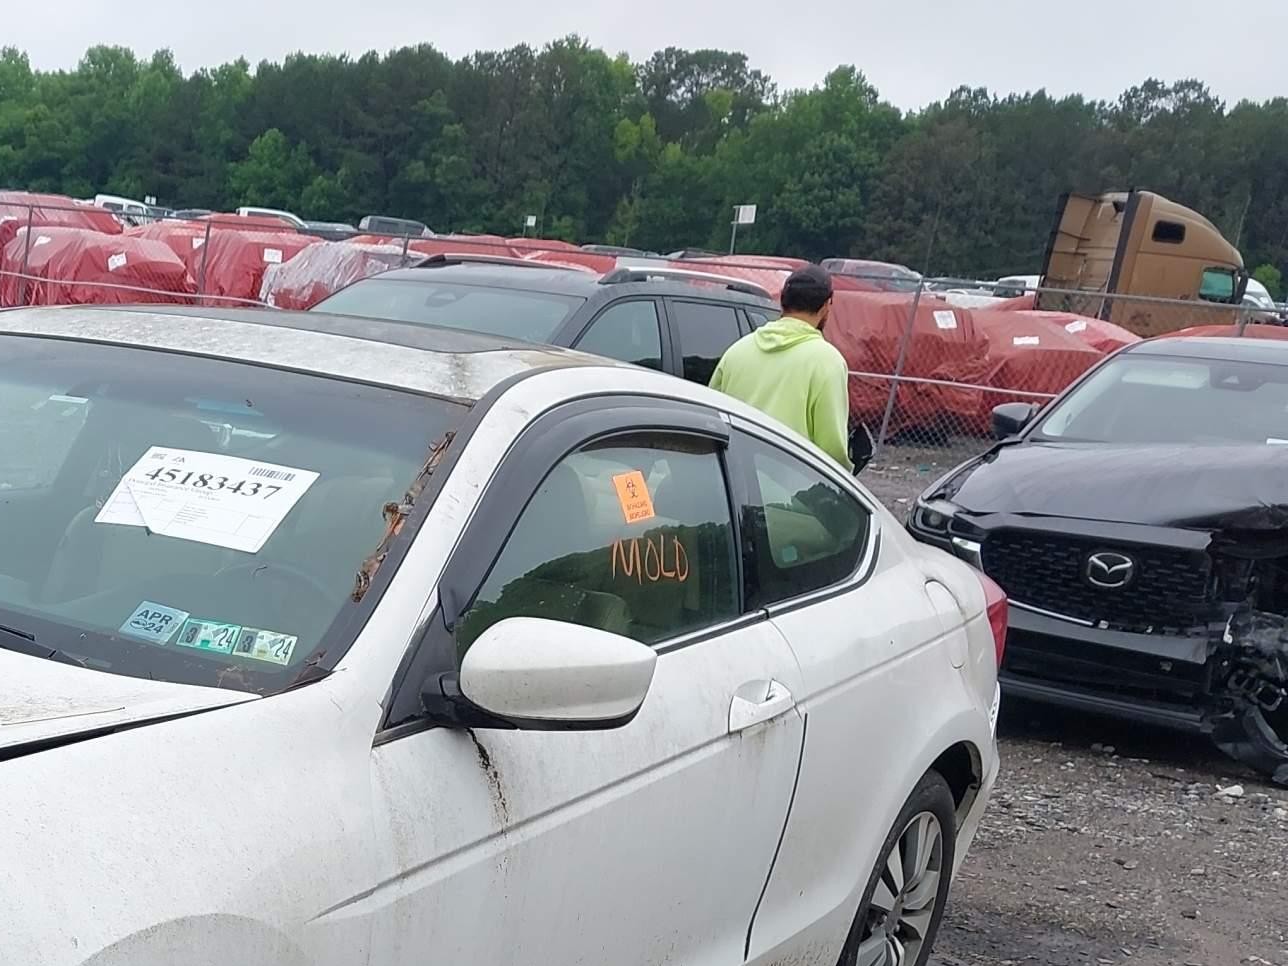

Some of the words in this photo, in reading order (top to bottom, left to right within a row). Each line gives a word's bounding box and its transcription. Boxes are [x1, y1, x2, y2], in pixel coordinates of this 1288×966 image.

[145, 466, 283, 500] 45183437
[612, 534, 690, 586] MOLD
[137, 609, 173, 625] APR
[144, 622, 164, 635] 24
[185, 627, 198, 644] 3
[217, 628, 235, 649] 24
[242, 635, 254, 653] 3
[274, 639, 292, 659] 24
